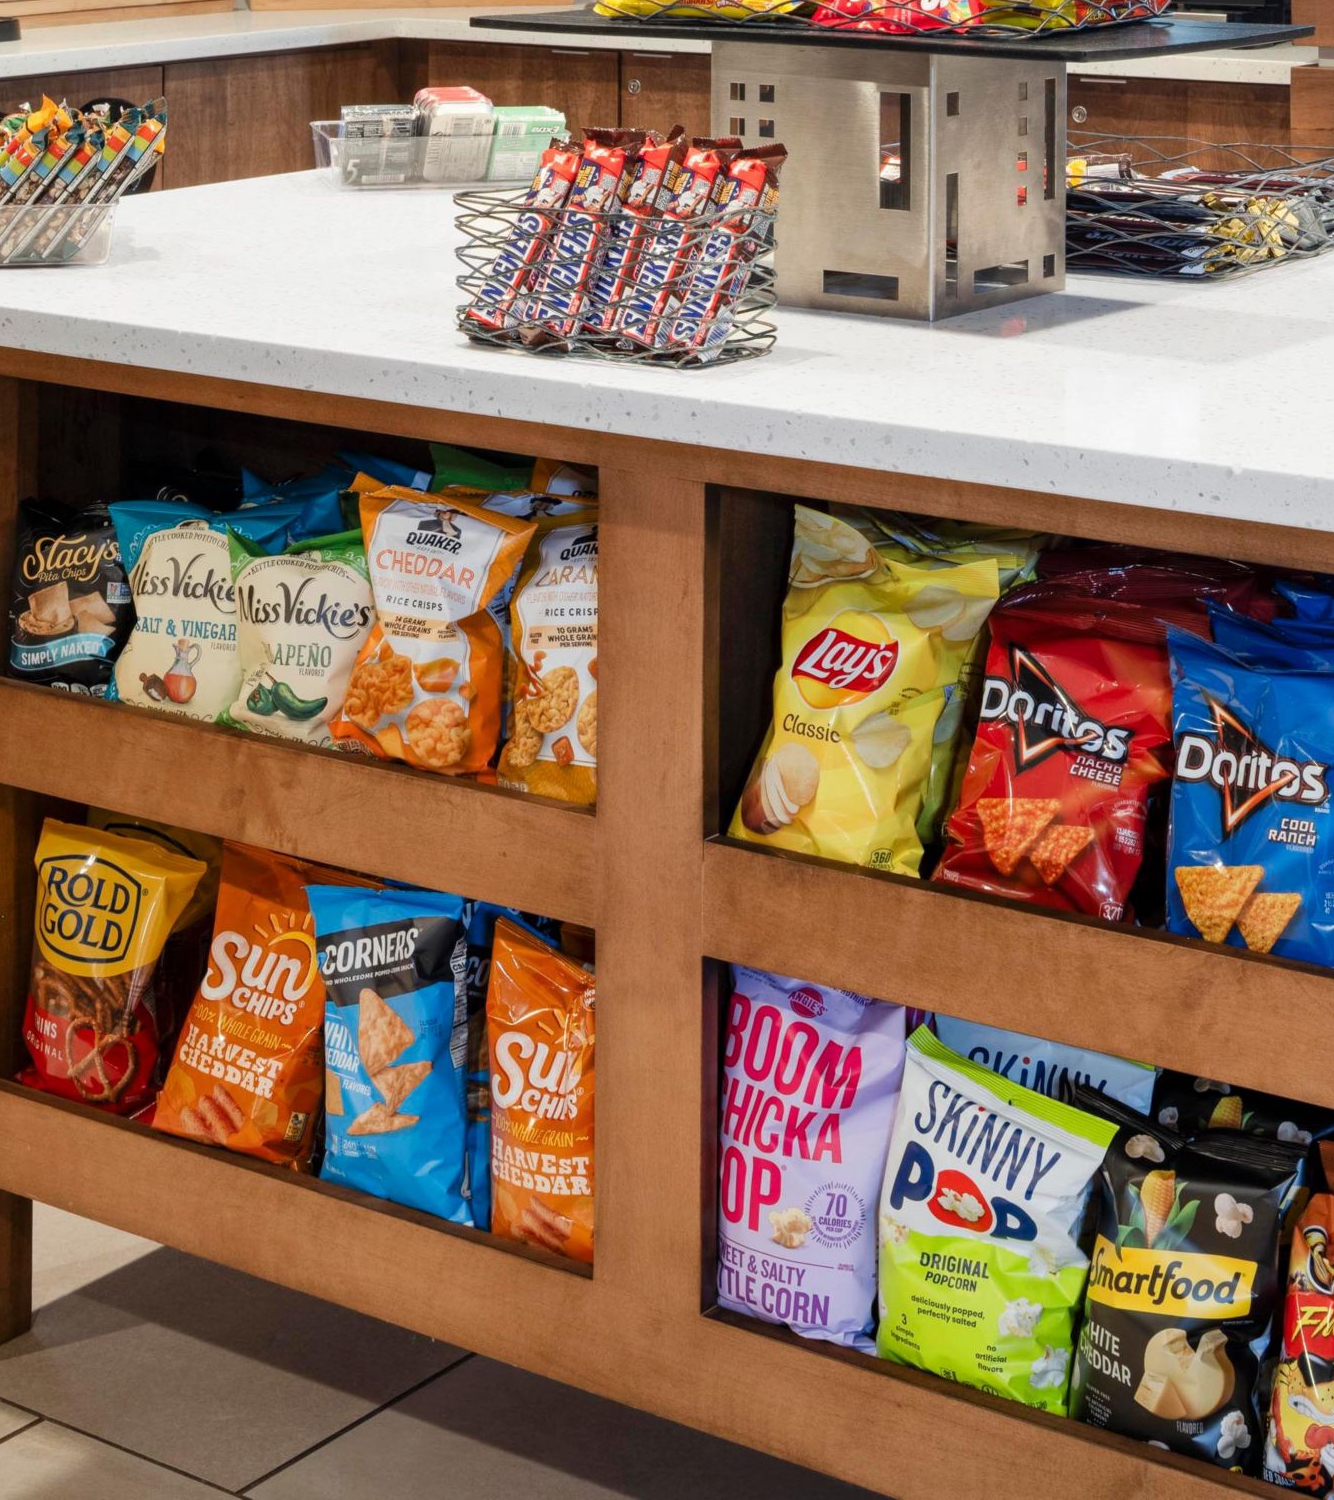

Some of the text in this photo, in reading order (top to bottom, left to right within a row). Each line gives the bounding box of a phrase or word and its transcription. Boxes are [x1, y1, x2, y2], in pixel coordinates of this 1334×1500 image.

[167, 531, 193, 541] COOKED
[406, 531, 462, 556] QUAKER
[23, 534, 120, 582] Stacy's
[250, 559, 348, 578] KETTLE COOKED CHIPS
[376, 549, 476, 590] CHEDDAR
[38, 567, 87, 583] Pita Chips
[238, 585, 279, 625] Miss
[275, 577, 372, 642] Vickie's
[386, 595, 444, 612] RICE CRISPS
[545, 608, 565, 618] RICE
[134, 616, 237, 641] SALT & VINEGAR
[384, 621, 432, 635] WHOLE GRAINS
[403, 617, 427, 627] GRAMS
[556, 626, 594, 635] 10 GRAMS
[21, 641, 100, 666] SIMPLY NAKED
[210, 642, 237, 652] FLAVORED
[796, 628, 895, 689] Lay's
[298, 668, 325, 678] FLAVORED
[782, 713, 842, 744] Classic
[982, 678, 1133, 762] Doritos
[1069, 764, 1122, 787] CHEESE
[1177, 735, 1328, 802] Doritos
[1268, 828, 1317, 847] RANCH
[1280, 817, 1317, 834] COOL
[871, 850, 892, 864] 360
[46, 866, 131, 916] ROLD
[42, 902, 123, 953] GOLD
[200, 930, 313, 1002] Sun
[334, 973, 374, 986] WHOLESOME
[231, 987, 300, 1026] CHIPS
[787, 990, 826, 1017] ANGIE'S
[217, 1011, 283, 1052] WHOLE GRAIN
[26, 1029, 64, 1062] ORIGINAL
[185, 1024, 284, 1080] HARVEST
[723, 992, 863, 1111] BOOM
[179, 1044, 274, 1100] CHEDDAR
[342, 1079, 372, 1098] FLAVORED
[511, 1124, 575, 1148] WHOLE GRAIN
[492, 1135, 590, 1176] HARVEST
[491, 1156, 592, 1198] CHEDDAR
[889, 1140, 1038, 1242] POP
[825, 1192, 848, 1218] 70
[818, 1216, 853, 1229] CALORIES
[748, 1255, 806, 1288] & SALTY
[919, 1251, 990, 1280] ORIGINAL
[924, 1270, 978, 1293] POPCORN
[1088, 1251, 1243, 1306] Smartfood
[762, 1281, 831, 1328] CORN
[910, 1295, 985, 1320] deliciously popped,
[901, 1313, 908, 1325] 3
[917, 1307, 977, 1328] perfectly salted
[890, 1330, 921, 1351] ingredients
[895, 1324, 914, 1338] simple
[975, 1352, 1007, 1364] artificial
[977, 1362, 1004, 1373] flavors
[1080, 1334, 1132, 1388] CHEDDAR
[1176, 1421, 1204, 1435] FLAVORED
